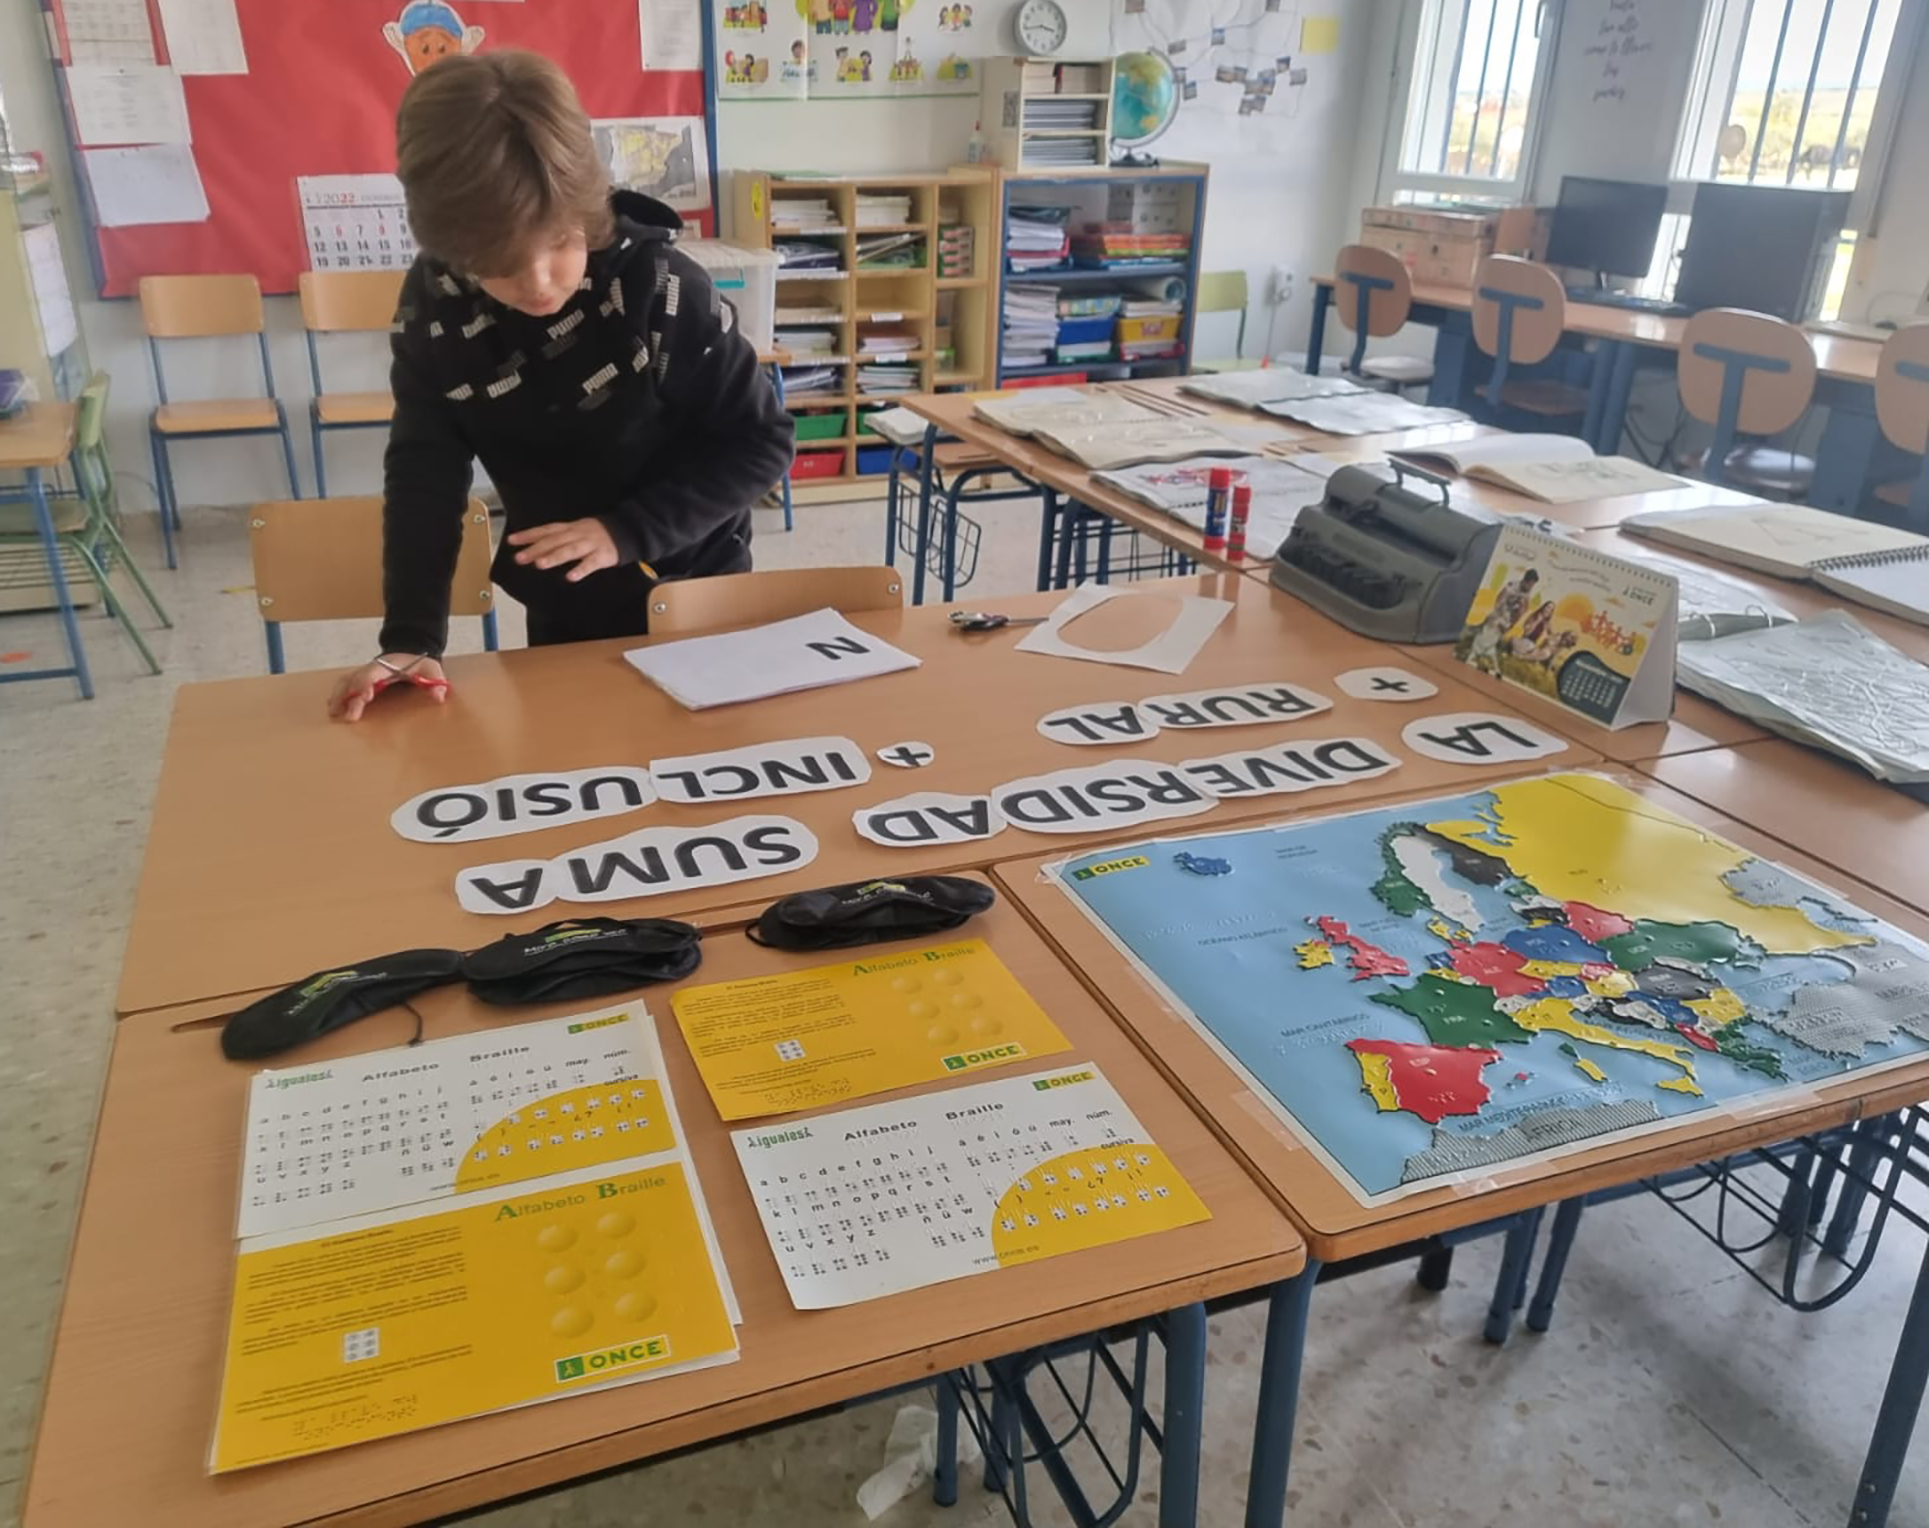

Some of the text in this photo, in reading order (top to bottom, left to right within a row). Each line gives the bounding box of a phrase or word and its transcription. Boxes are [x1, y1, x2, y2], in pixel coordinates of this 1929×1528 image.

[314, 242, 327, 252] 12
[357, 241, 370, 251] 14
[806, 635, 872, 661] N
[1418, 721, 1539, 756] LA
[1094, 857, 1147, 874] ONCE
[853, 948, 975, 976] Alfabeto Braille
[583, 1013, 628, 1030] ONCE
[967, 1045, 1019, 1063] ONCE
[361, 1063, 439, 1082] Alfabeto
[1050, 1071, 1093, 1087] ONCE
[844, 1103, 1004, 1141] Alfabeto Braille
[1049, 1117, 1076, 1129] may.
[1086, 1109, 1113, 1121] núm.
[757, 1129, 804, 1149] iguales
[1100, 1137, 1135, 1151] cursiva
[494, 1175, 666, 1222] Alfabeto Braille
[589, 1341, 662, 1369] ONCE
